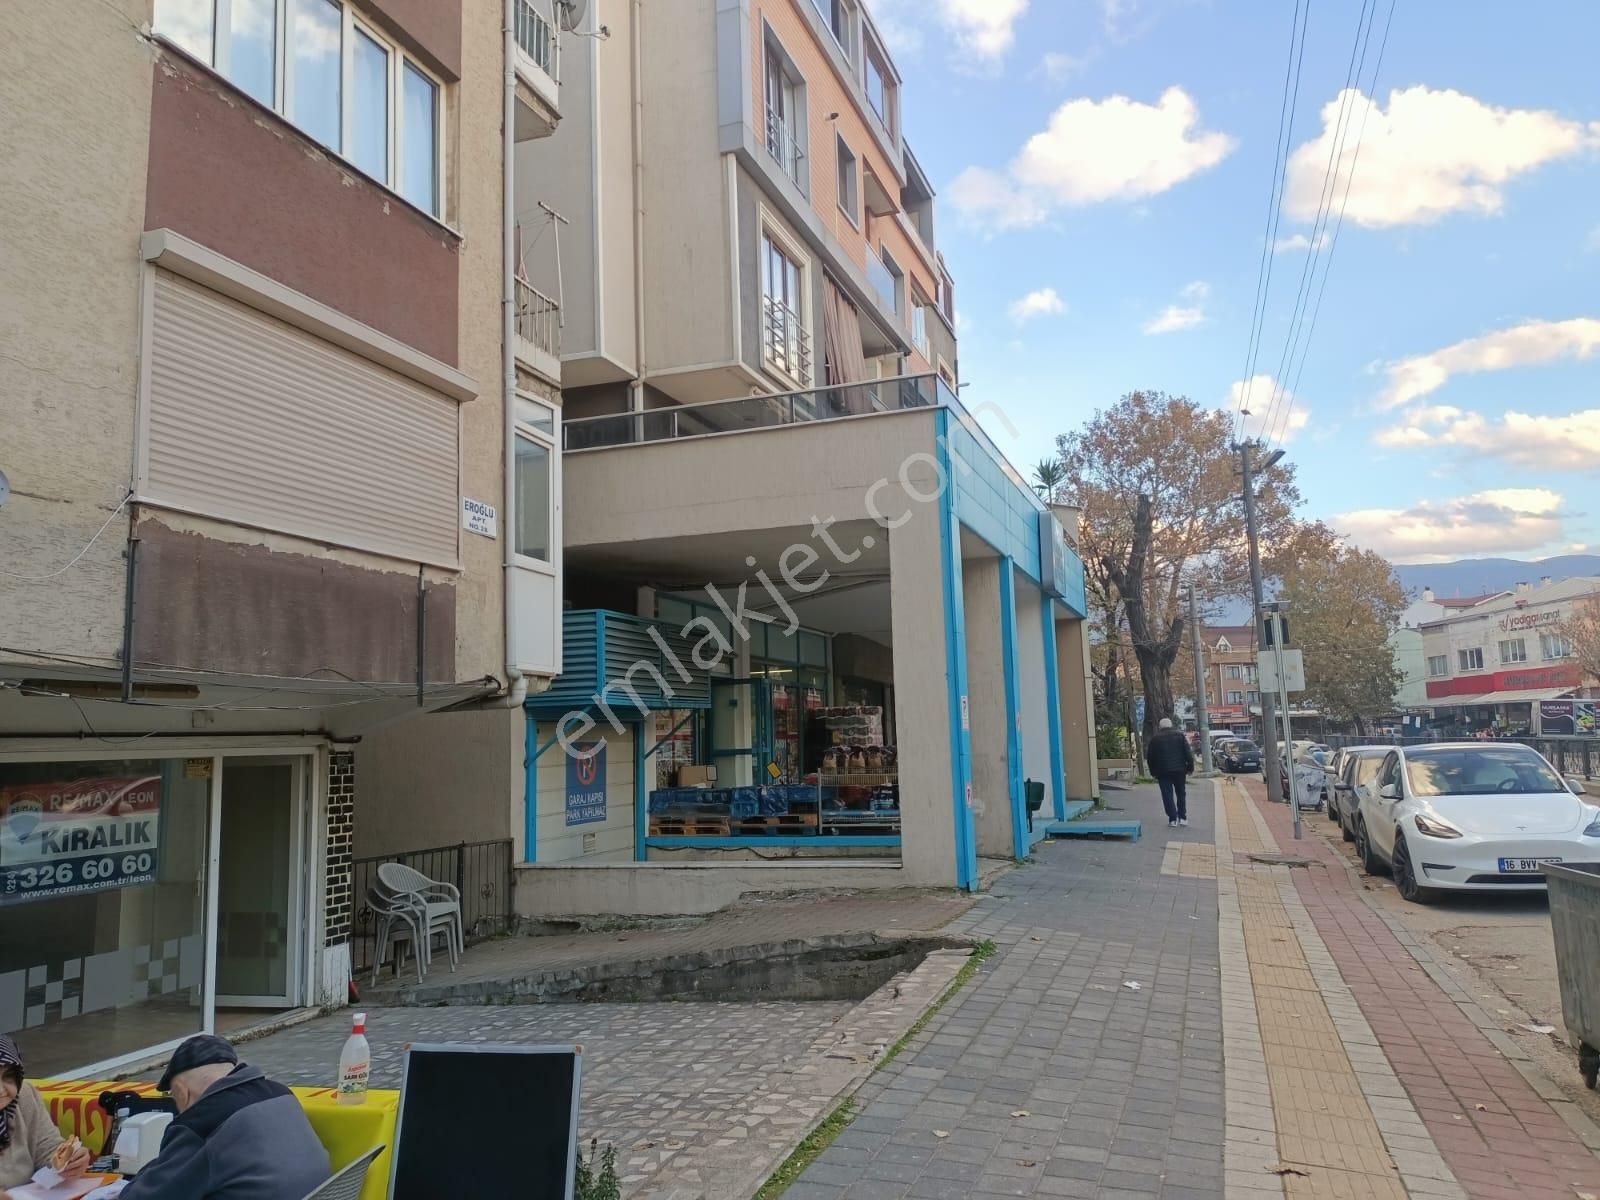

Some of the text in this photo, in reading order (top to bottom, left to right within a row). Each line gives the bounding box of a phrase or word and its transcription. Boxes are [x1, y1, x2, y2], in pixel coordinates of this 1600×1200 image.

[464, 500, 494, 518] EROĞLU
[50, 791, 116, 810] RE/MAX
[20, 862, 73, 889] 326
[82, 858, 115, 880] 60
[121, 853, 151, 874] 60
[21, 874, 152, 899] www.remax.com.tr/leon
